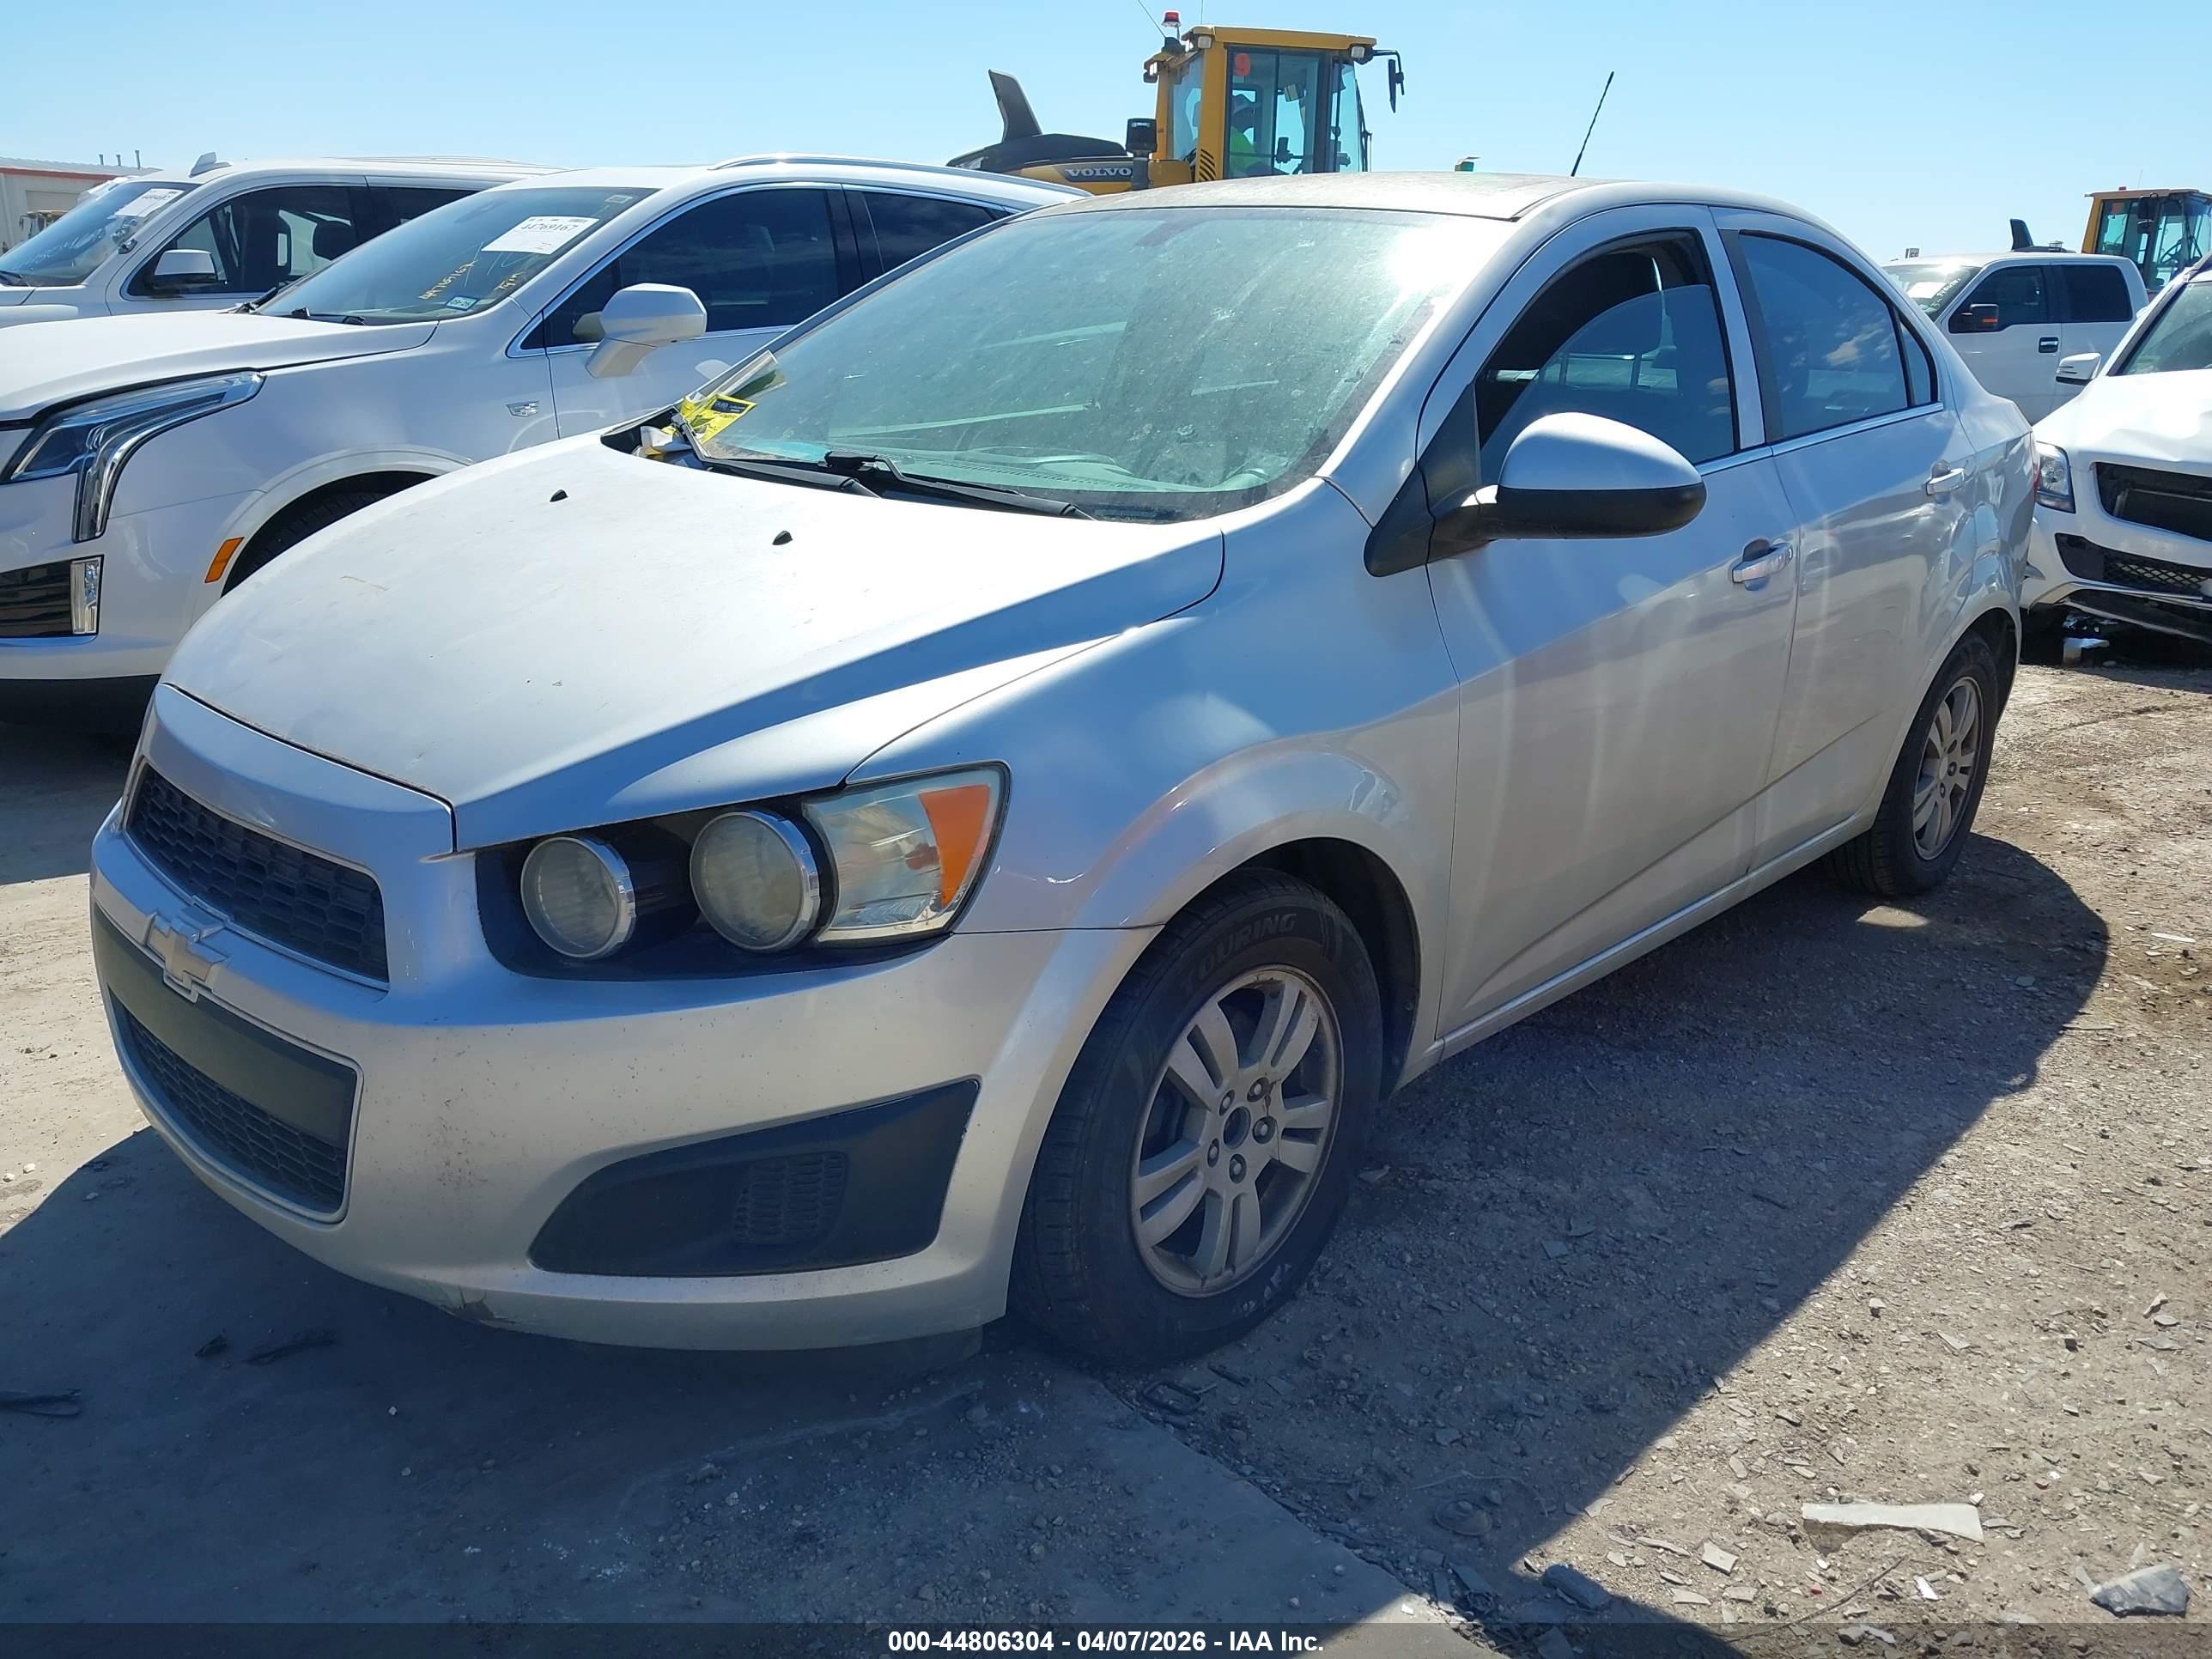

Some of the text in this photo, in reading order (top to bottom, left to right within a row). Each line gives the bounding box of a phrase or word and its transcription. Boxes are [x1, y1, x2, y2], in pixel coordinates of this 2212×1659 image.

[1064, 167, 1132, 177] VOLVO
[520, 222, 579, 231] 44769167
[1180, 912, 1297, 994] TOURING
